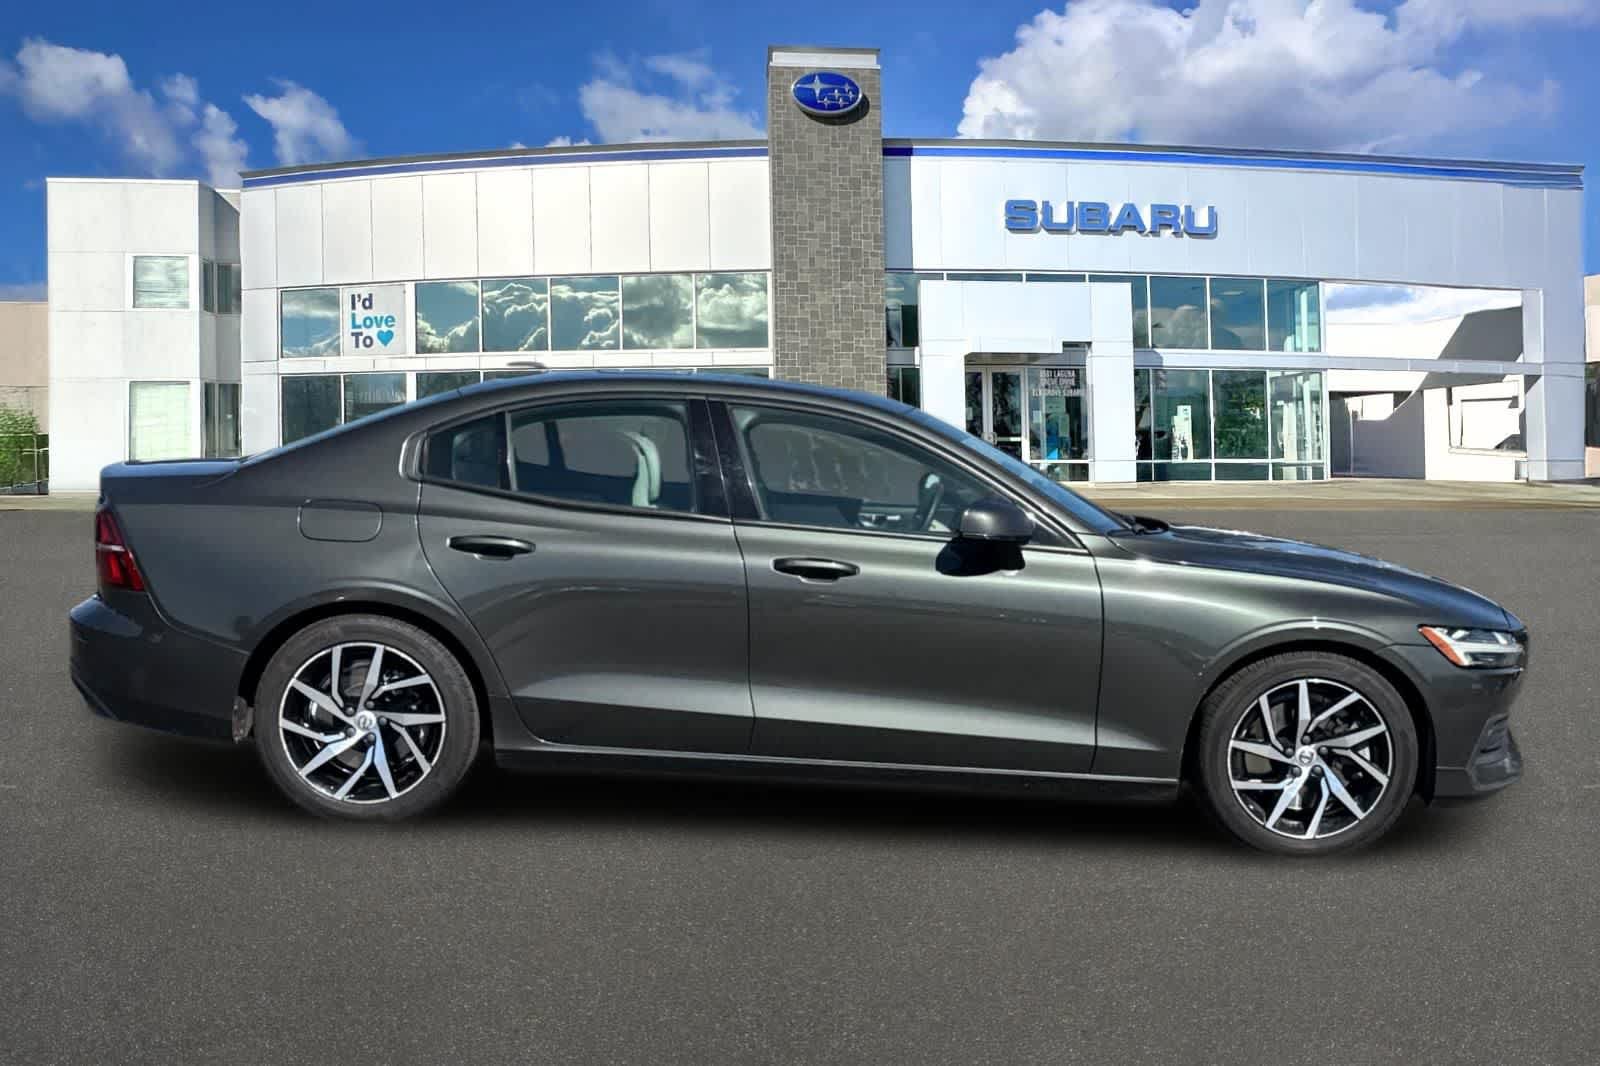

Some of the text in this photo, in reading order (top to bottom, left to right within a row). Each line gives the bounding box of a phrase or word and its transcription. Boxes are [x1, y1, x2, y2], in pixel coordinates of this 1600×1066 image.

[1004, 199, 1217, 237] SUBARU
[351, 293, 373, 310] I'd
[351, 312, 395, 329] Love
[351, 331, 374, 349] To
